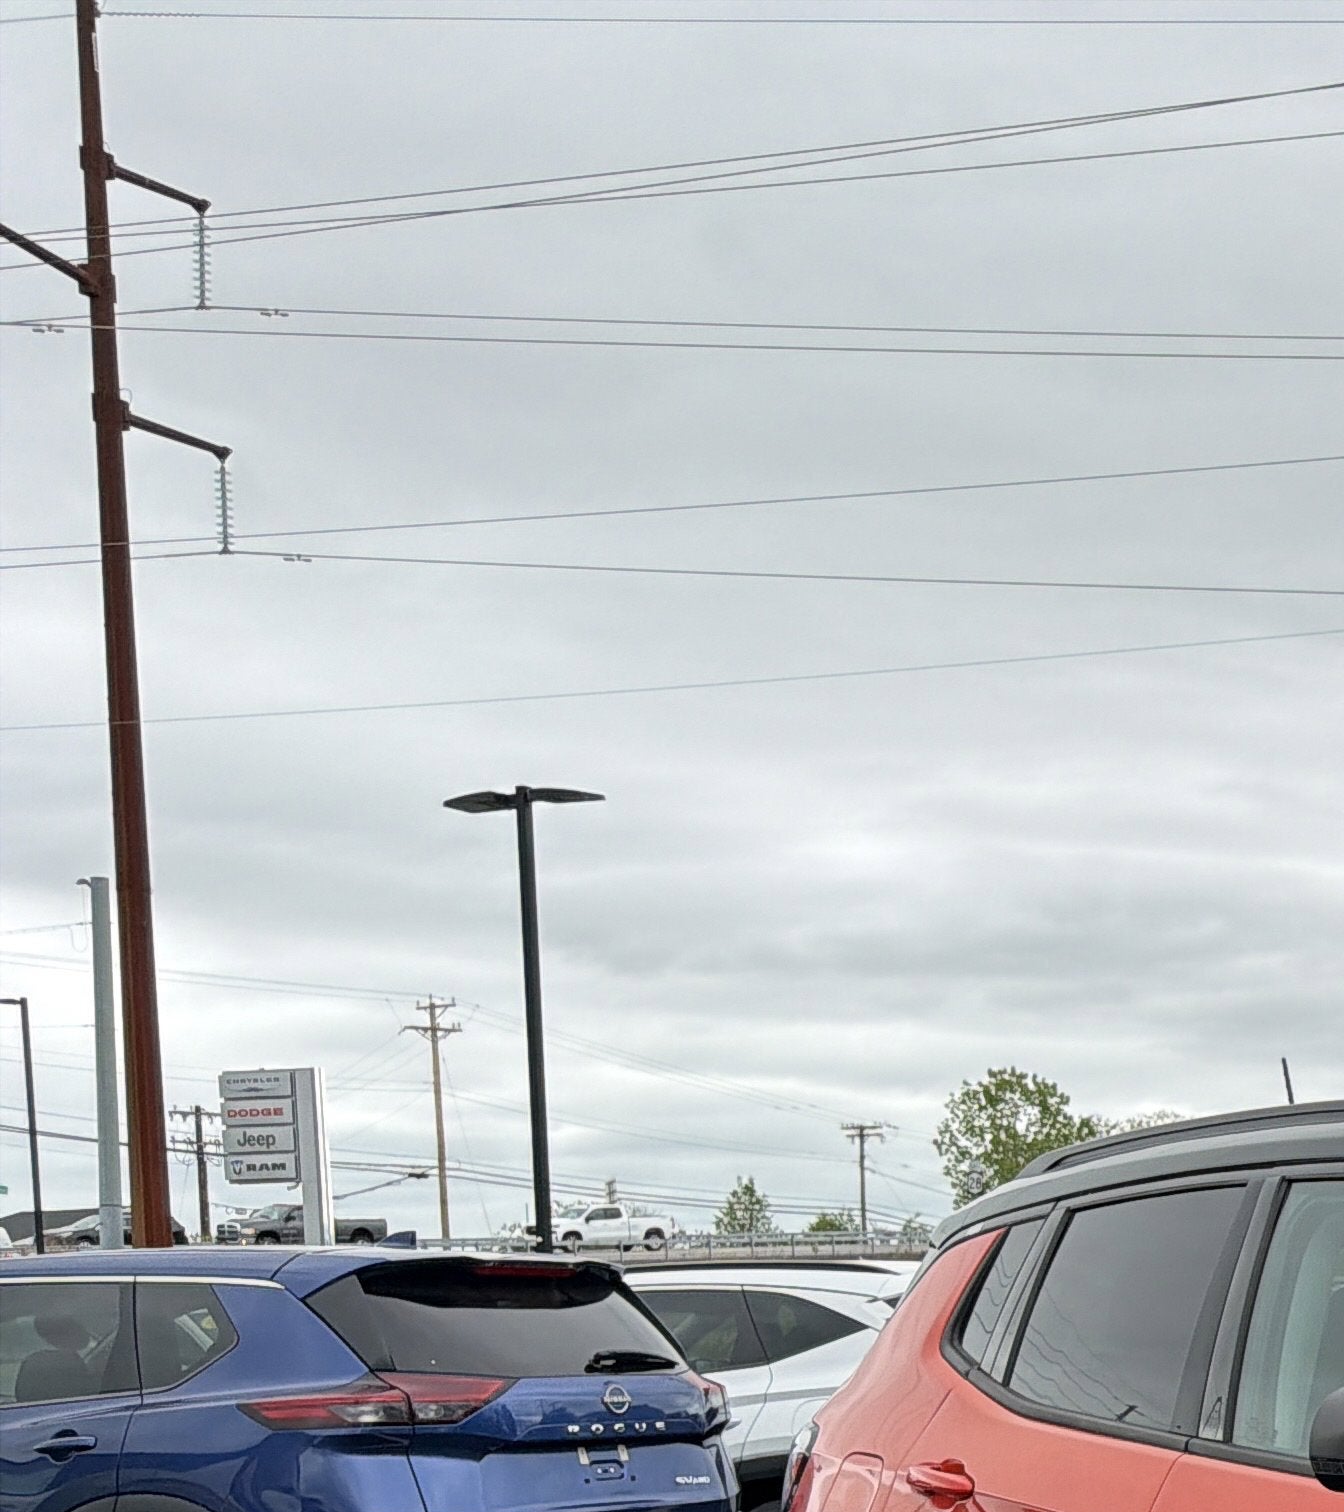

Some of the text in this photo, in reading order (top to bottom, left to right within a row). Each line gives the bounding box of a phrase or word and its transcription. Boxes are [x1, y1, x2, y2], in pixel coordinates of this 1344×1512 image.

[226, 1077, 280, 1085] CHRYSLER
[227, 1107, 284, 1119] DODGE
[237, 1131, 276, 1148] Jeep
[246, 1162, 287, 1172] RAM
[567, 1421, 667, 1434] ROGUE
